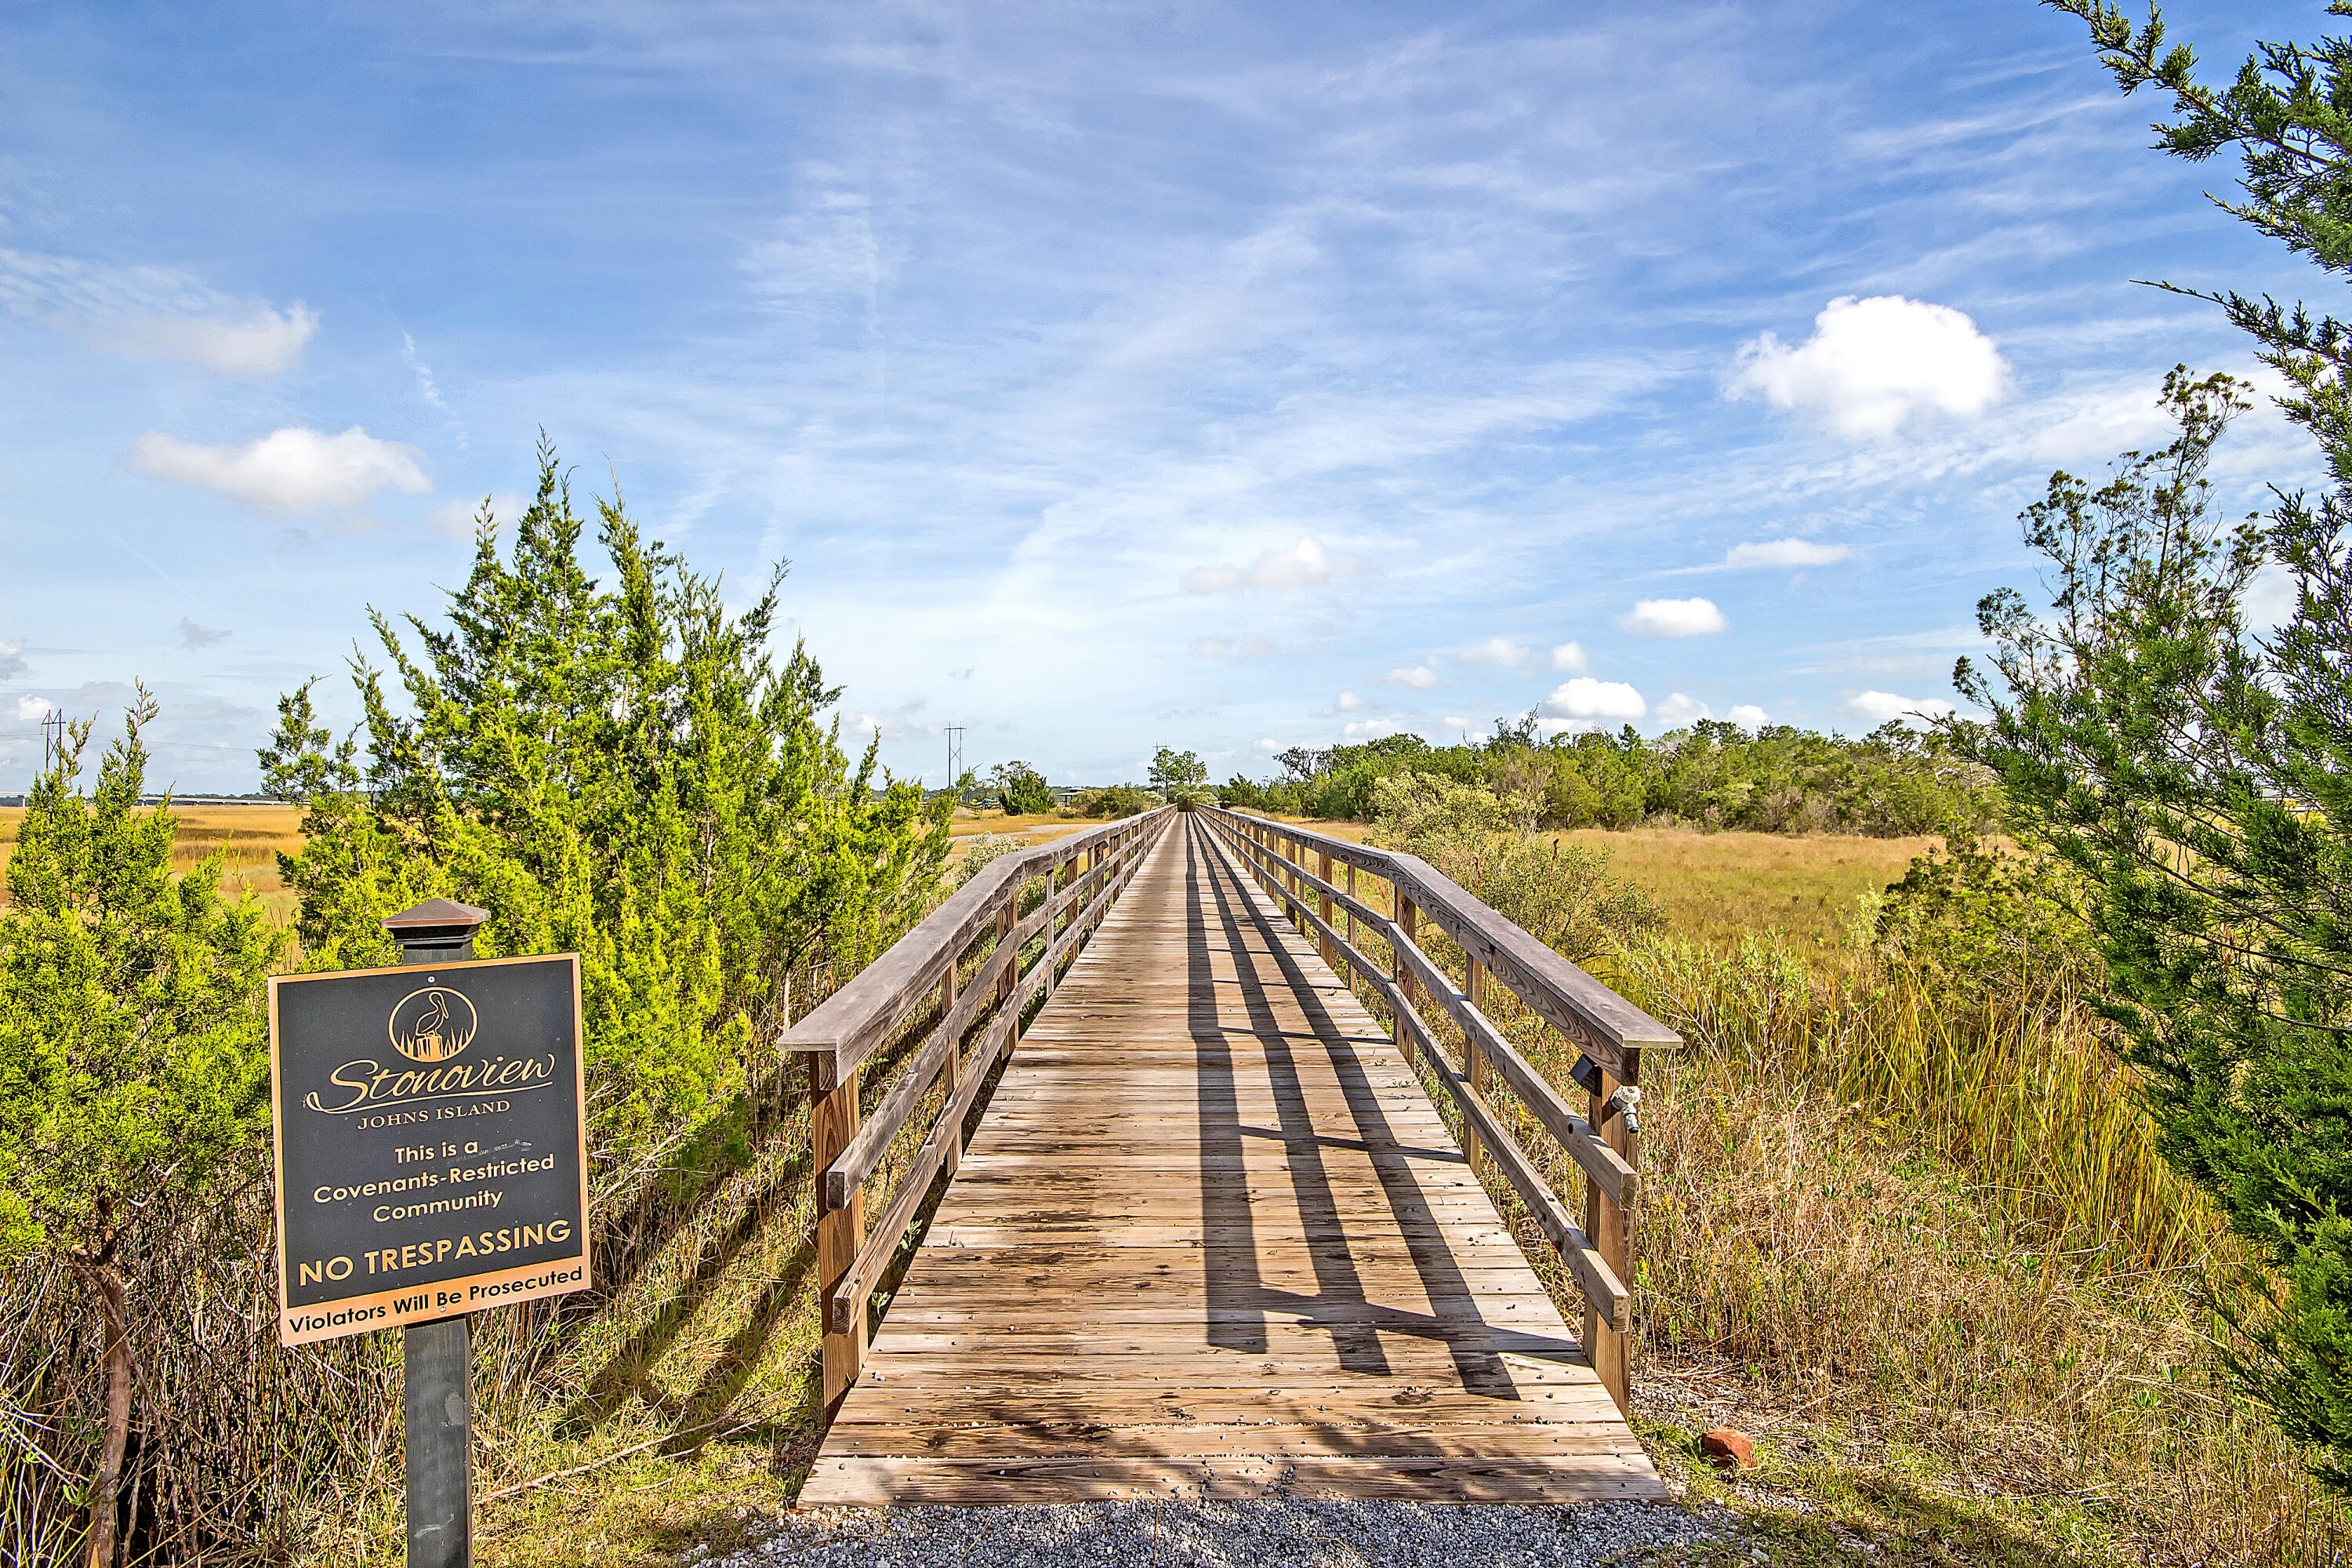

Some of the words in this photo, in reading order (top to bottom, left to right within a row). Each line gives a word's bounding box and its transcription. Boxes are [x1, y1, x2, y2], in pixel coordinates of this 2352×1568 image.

[305, 1053, 556, 1114] Stonoview
[358, 1110, 430, 1130] JOHNS
[436, 1100, 511, 1120] ISLAND
[395, 1144, 434, 1164] This
[442, 1142, 457, 1158] is
[464, 1141, 479, 1154] a
[314, 1154, 555, 1203] Covenants-Restricted
[372, 1190, 503, 1223] Community
[299, 1256, 354, 1287] NO
[364, 1219, 572, 1275] TRESPASSING
[289, 1302, 387, 1333] Violators
[393, 1293, 430, 1314] Will
[437, 1290, 463, 1307] Be
[469, 1266, 583, 1301] Prosecuted
